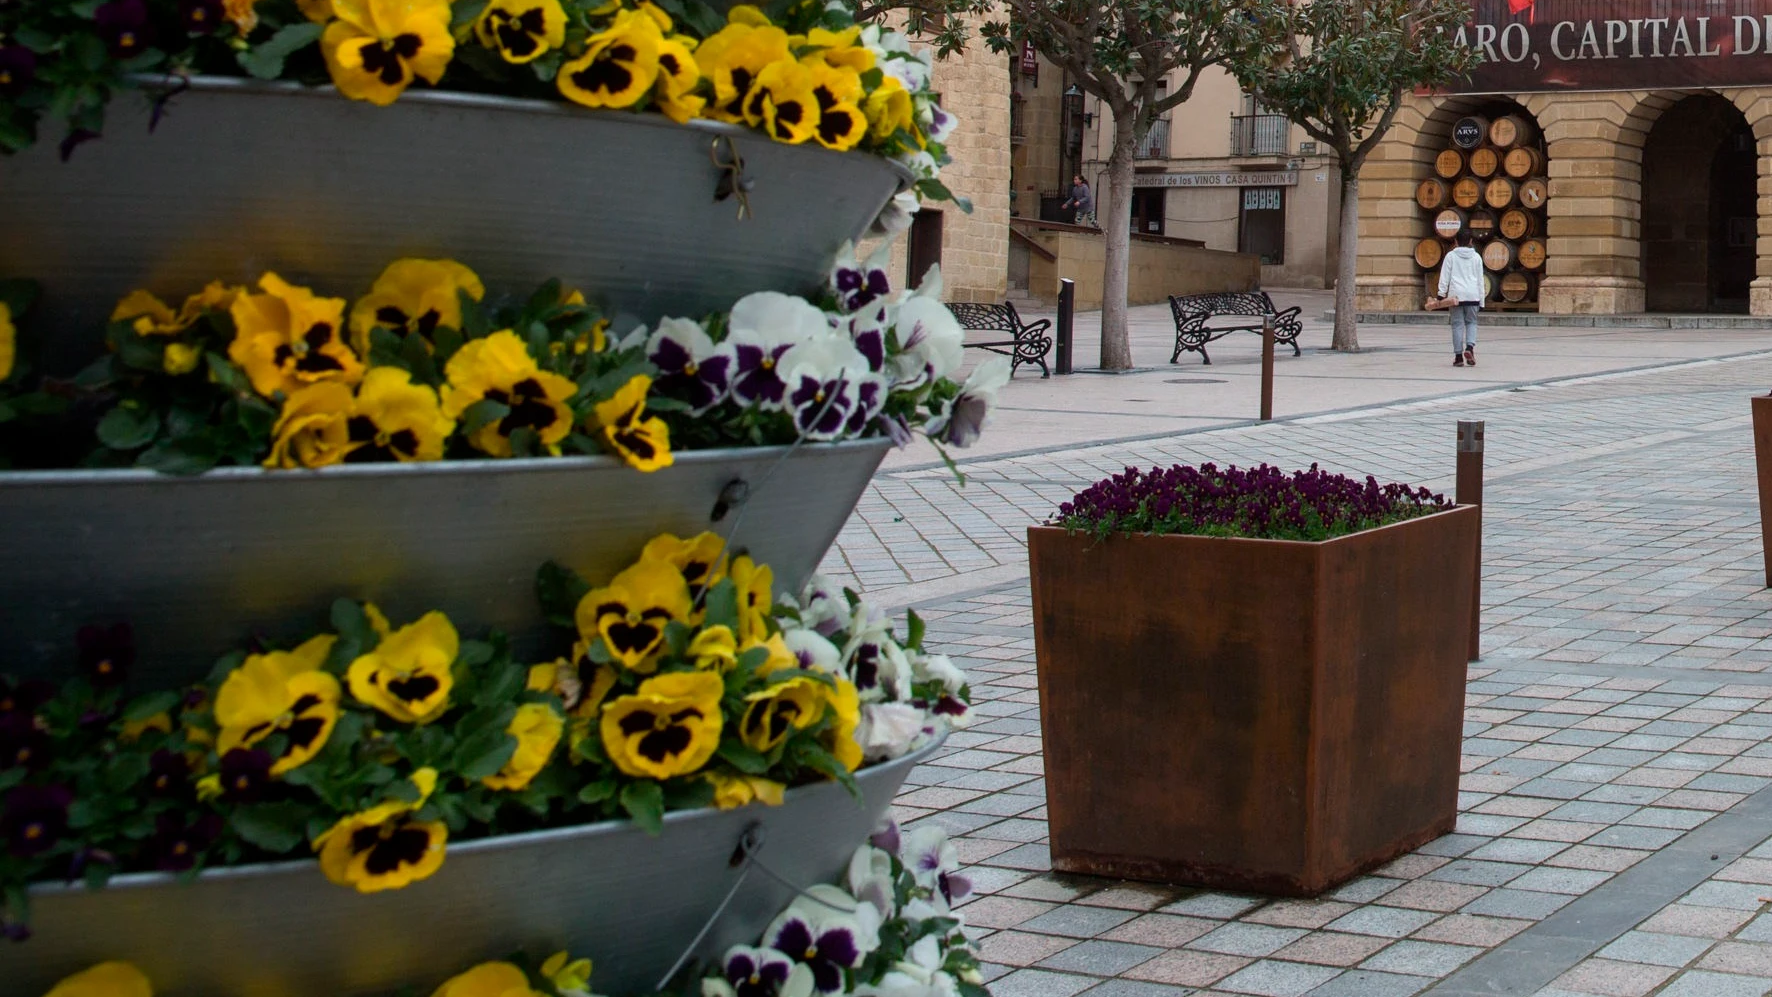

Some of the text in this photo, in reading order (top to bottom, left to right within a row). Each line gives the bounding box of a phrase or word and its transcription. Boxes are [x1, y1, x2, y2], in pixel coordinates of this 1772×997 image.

[1436, 22, 1541, 71] ARO,
[1550, 16, 1721, 61] CAPITAL
[1167, 175, 1177, 185] de
[1179, 174, 1192, 185] los
[1194, 173, 1221, 185] VINOS
[1225, 174, 1249, 184] CASA
